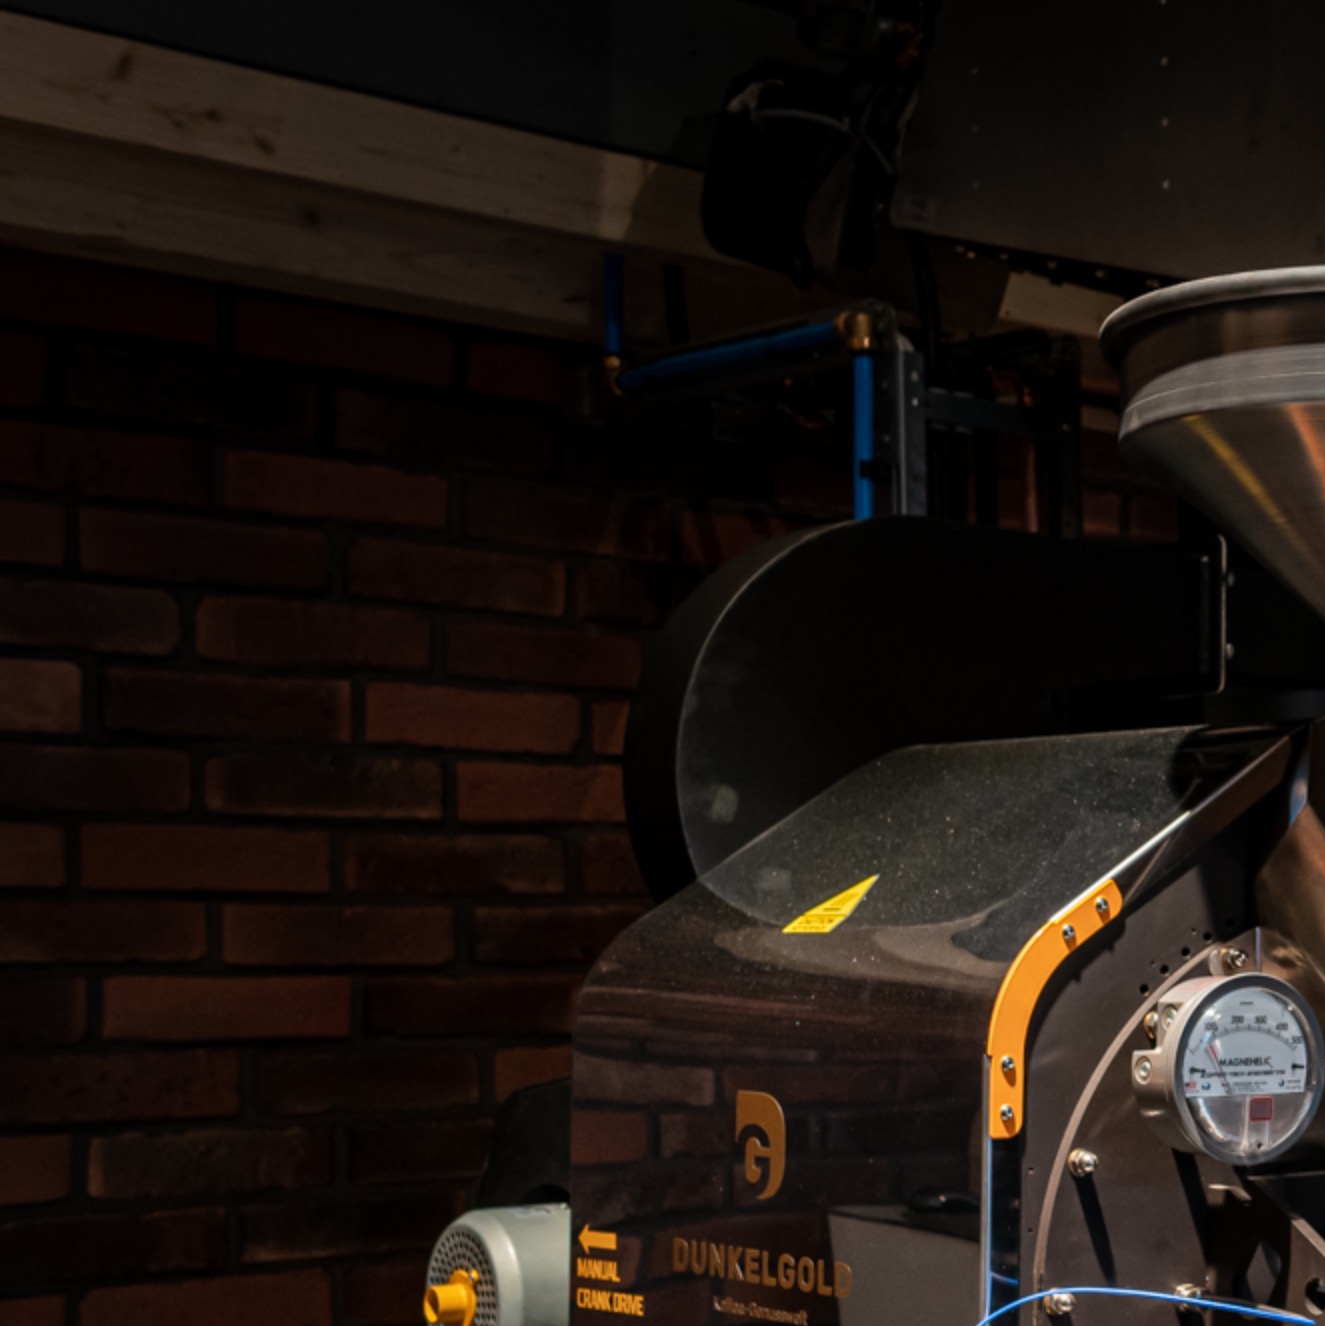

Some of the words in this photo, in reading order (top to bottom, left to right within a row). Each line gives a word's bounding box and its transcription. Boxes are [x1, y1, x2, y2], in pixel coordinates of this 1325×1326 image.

[576, 1256, 621, 1283] MANUAL
[672, 1237, 852, 1297] DUNKELGOLD
[576, 1286, 613, 1312] CRANK
[613, 1291, 646, 1318] DRIVE
